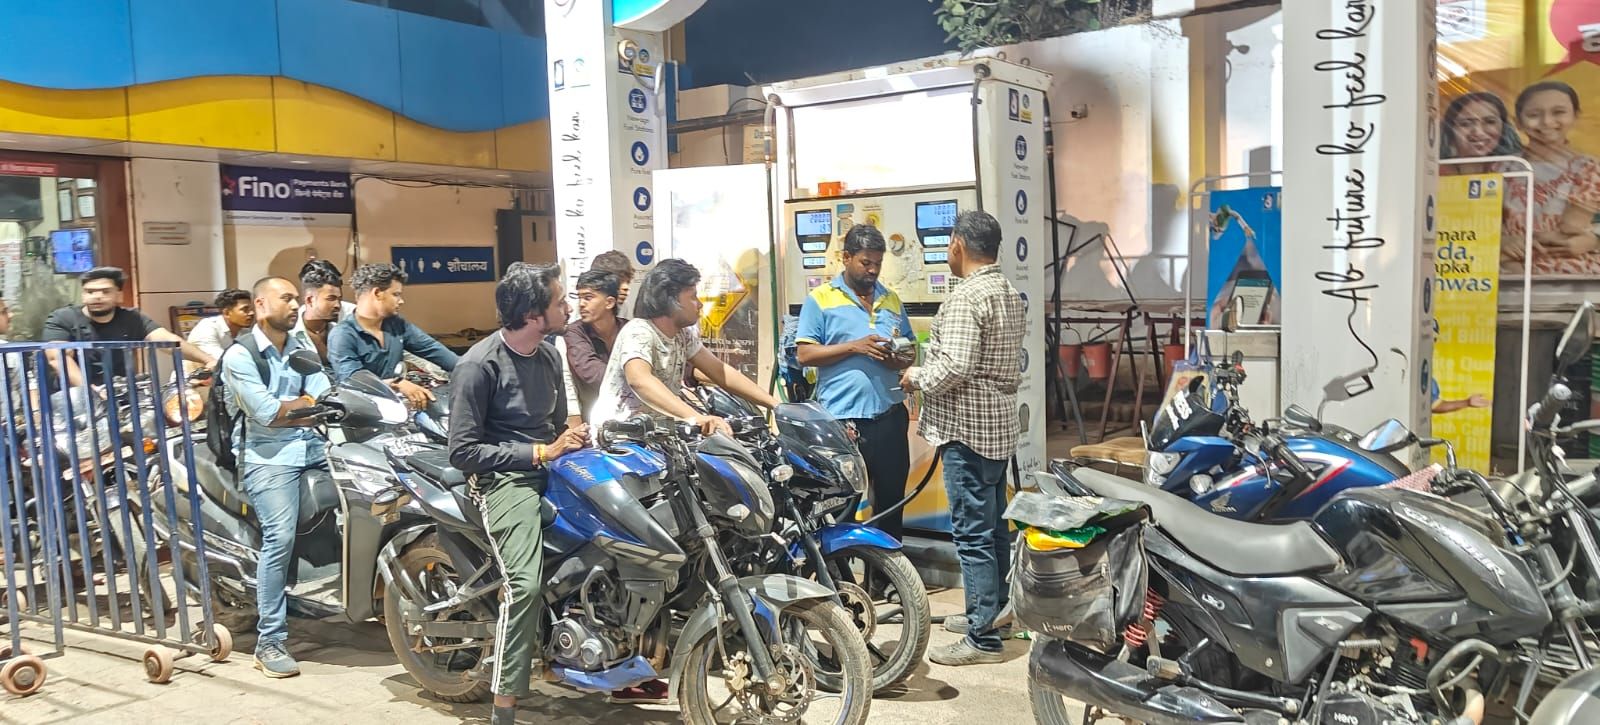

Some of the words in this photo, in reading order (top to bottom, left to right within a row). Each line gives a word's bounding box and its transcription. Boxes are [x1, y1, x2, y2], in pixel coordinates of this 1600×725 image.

[1314, 52, 1386, 109] feel
[1316, 121, 1374, 154] ko
[238, 176, 290, 199] Fino
[1322, 168, 1385, 250] future
[447, 257, 488, 273] शौचालय
[1315, 263, 1379, 302] Ab
